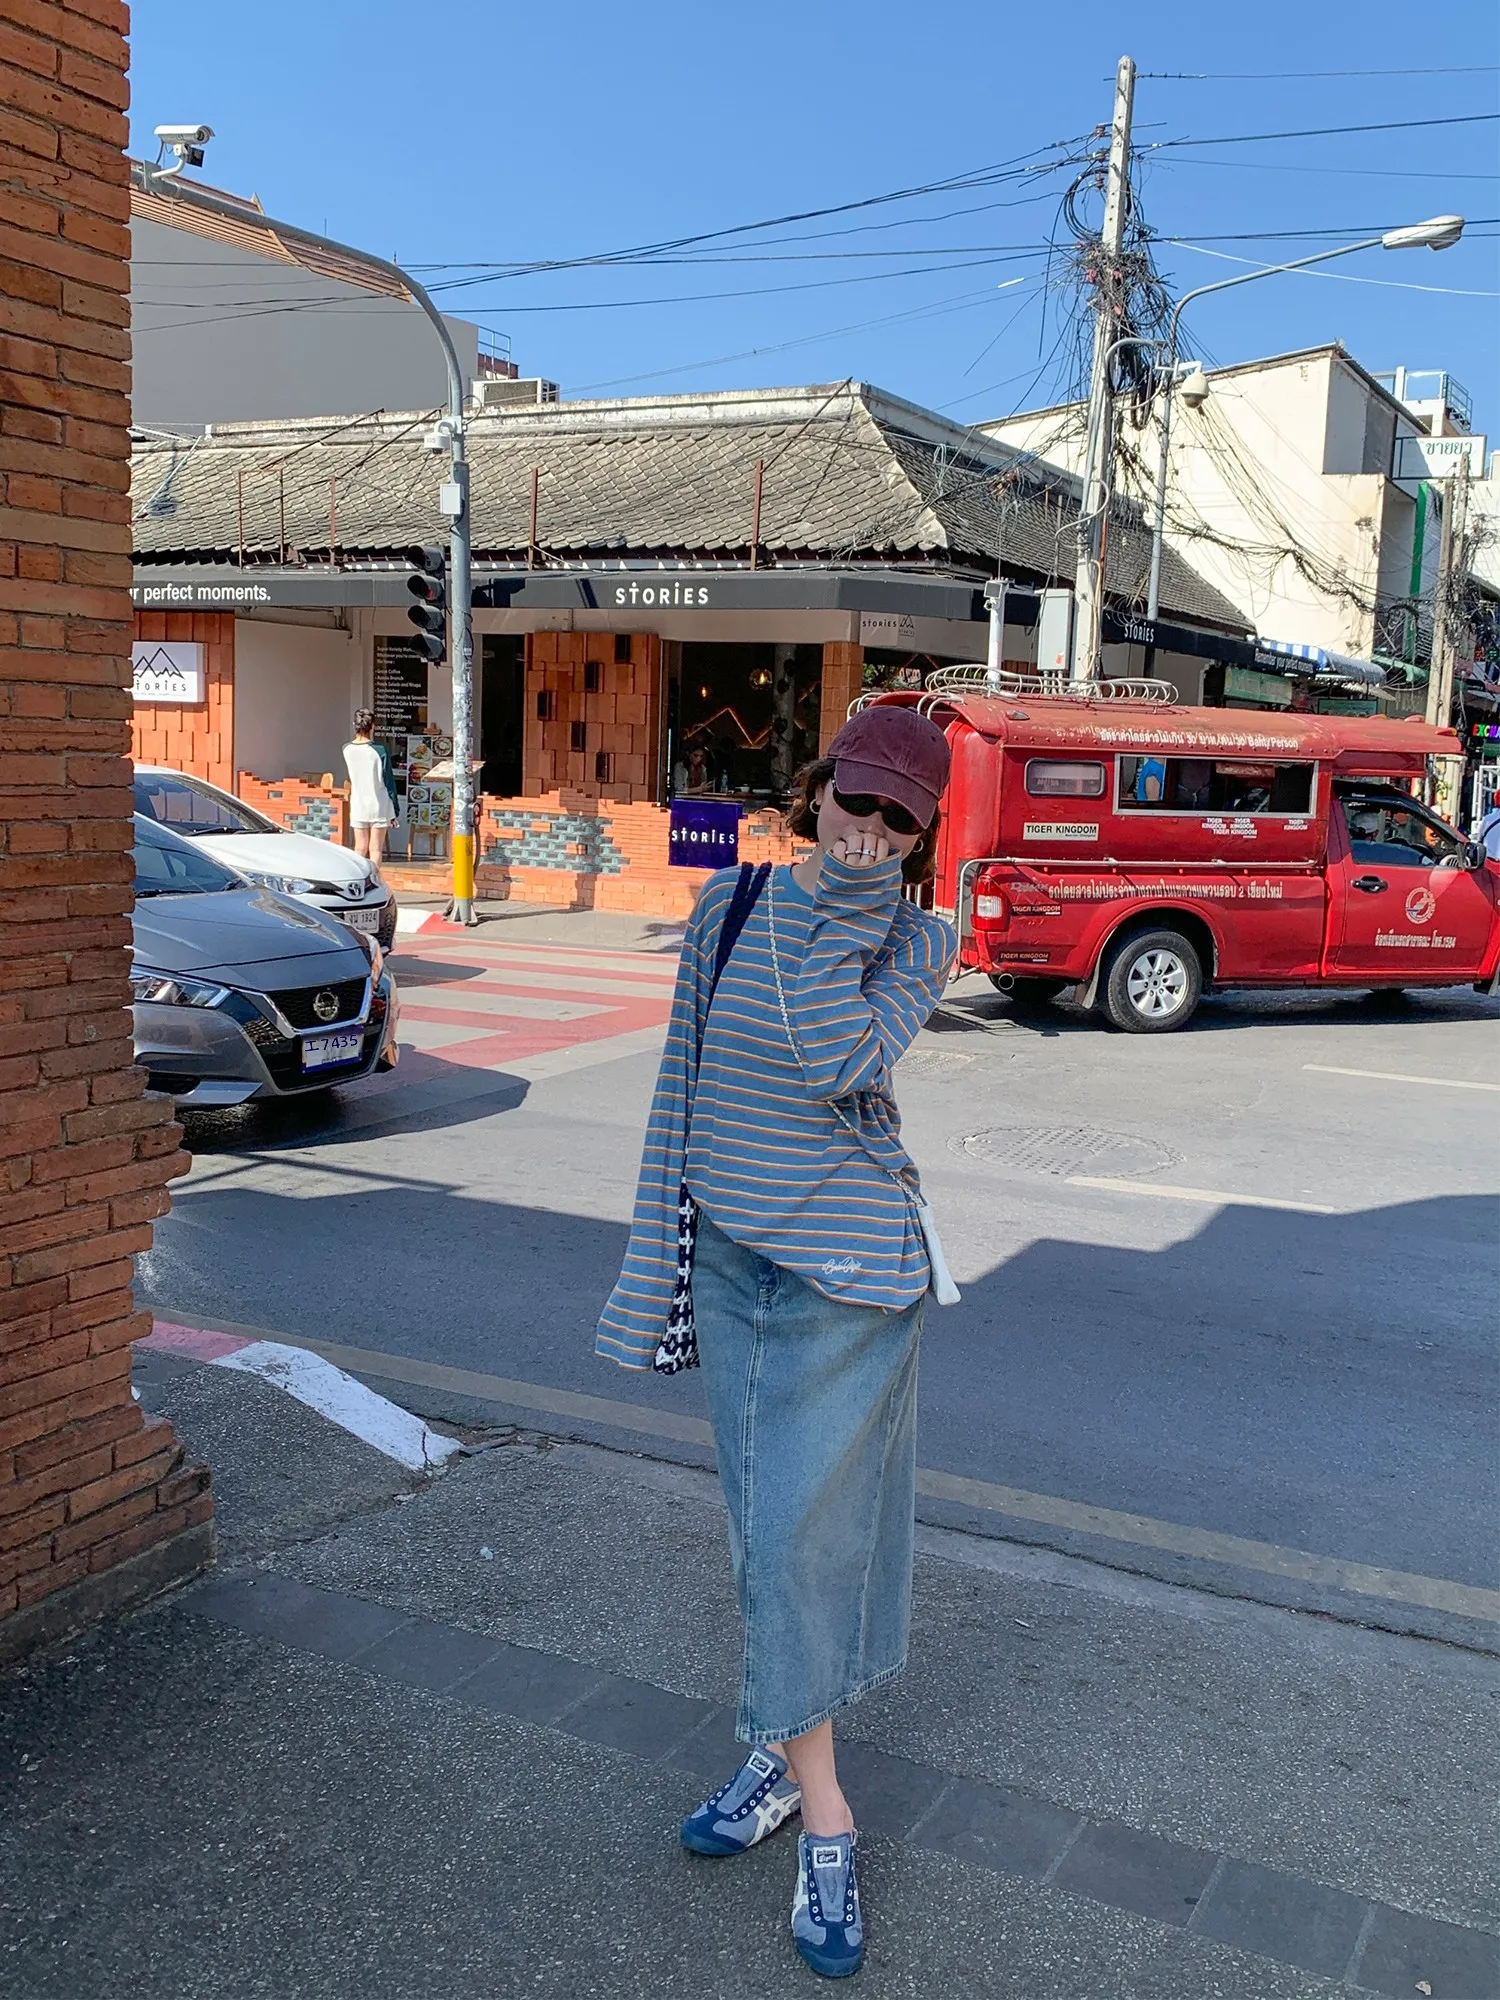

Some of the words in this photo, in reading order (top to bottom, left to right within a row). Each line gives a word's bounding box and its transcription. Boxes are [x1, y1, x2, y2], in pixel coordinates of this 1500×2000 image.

[143, 583, 194, 604] perfect
[197, 585, 272, 600] moments.
[615, 581, 709, 605] STORIES
[1124, 618, 1155, 643] STORIES
[135, 679, 187, 691] TORIES
[671, 827, 735, 844] STORIES
[1026, 825, 1053, 834] TIGER
[1056, 825, 1097, 834] KINGDOM
[1239, 888, 1245, 899] 2
